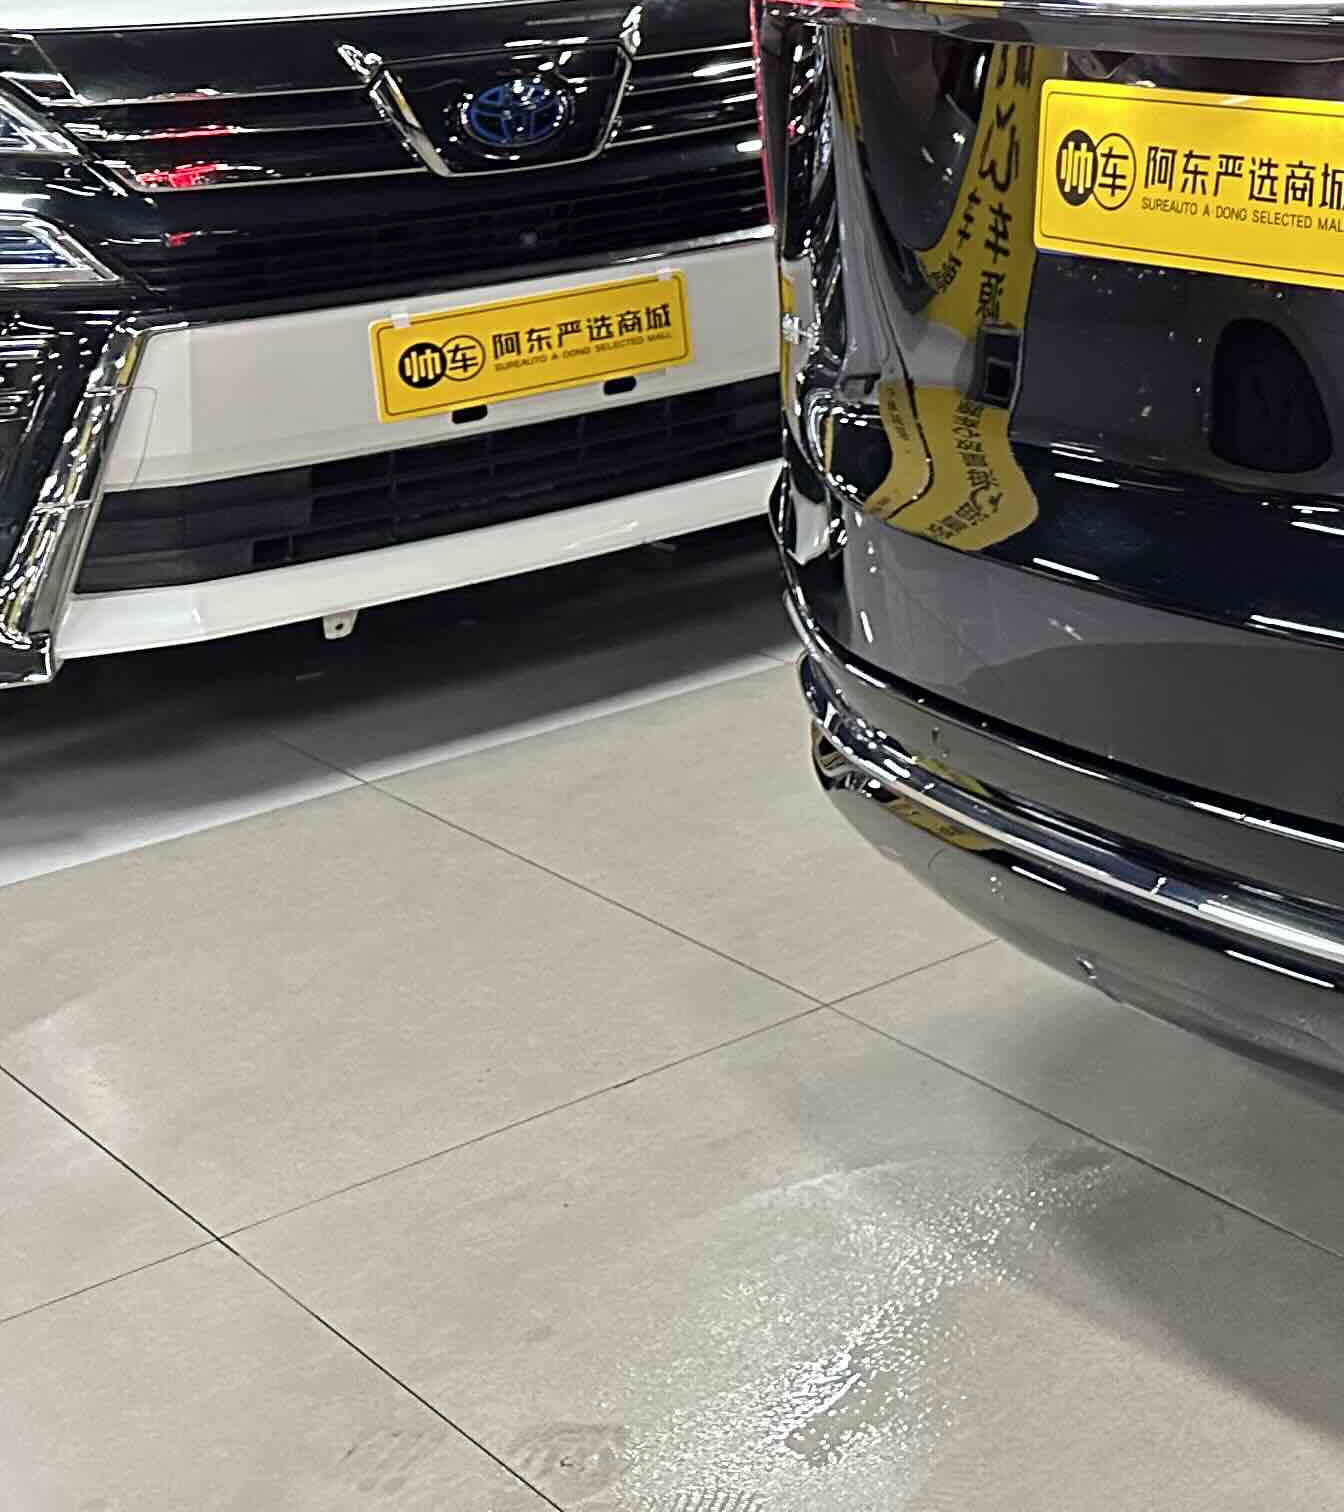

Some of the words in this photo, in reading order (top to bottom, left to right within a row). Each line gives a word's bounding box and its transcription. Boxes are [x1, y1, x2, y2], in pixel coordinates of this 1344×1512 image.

[1141, 197, 1198, 216] SUREAUTO
[1202, 203, 1210, 218] A
[1215, 205, 1248, 223] DONG
[1251, 209, 1312, 230] SELECTED
[492, 303, 672, 361] 阿东严选商城
